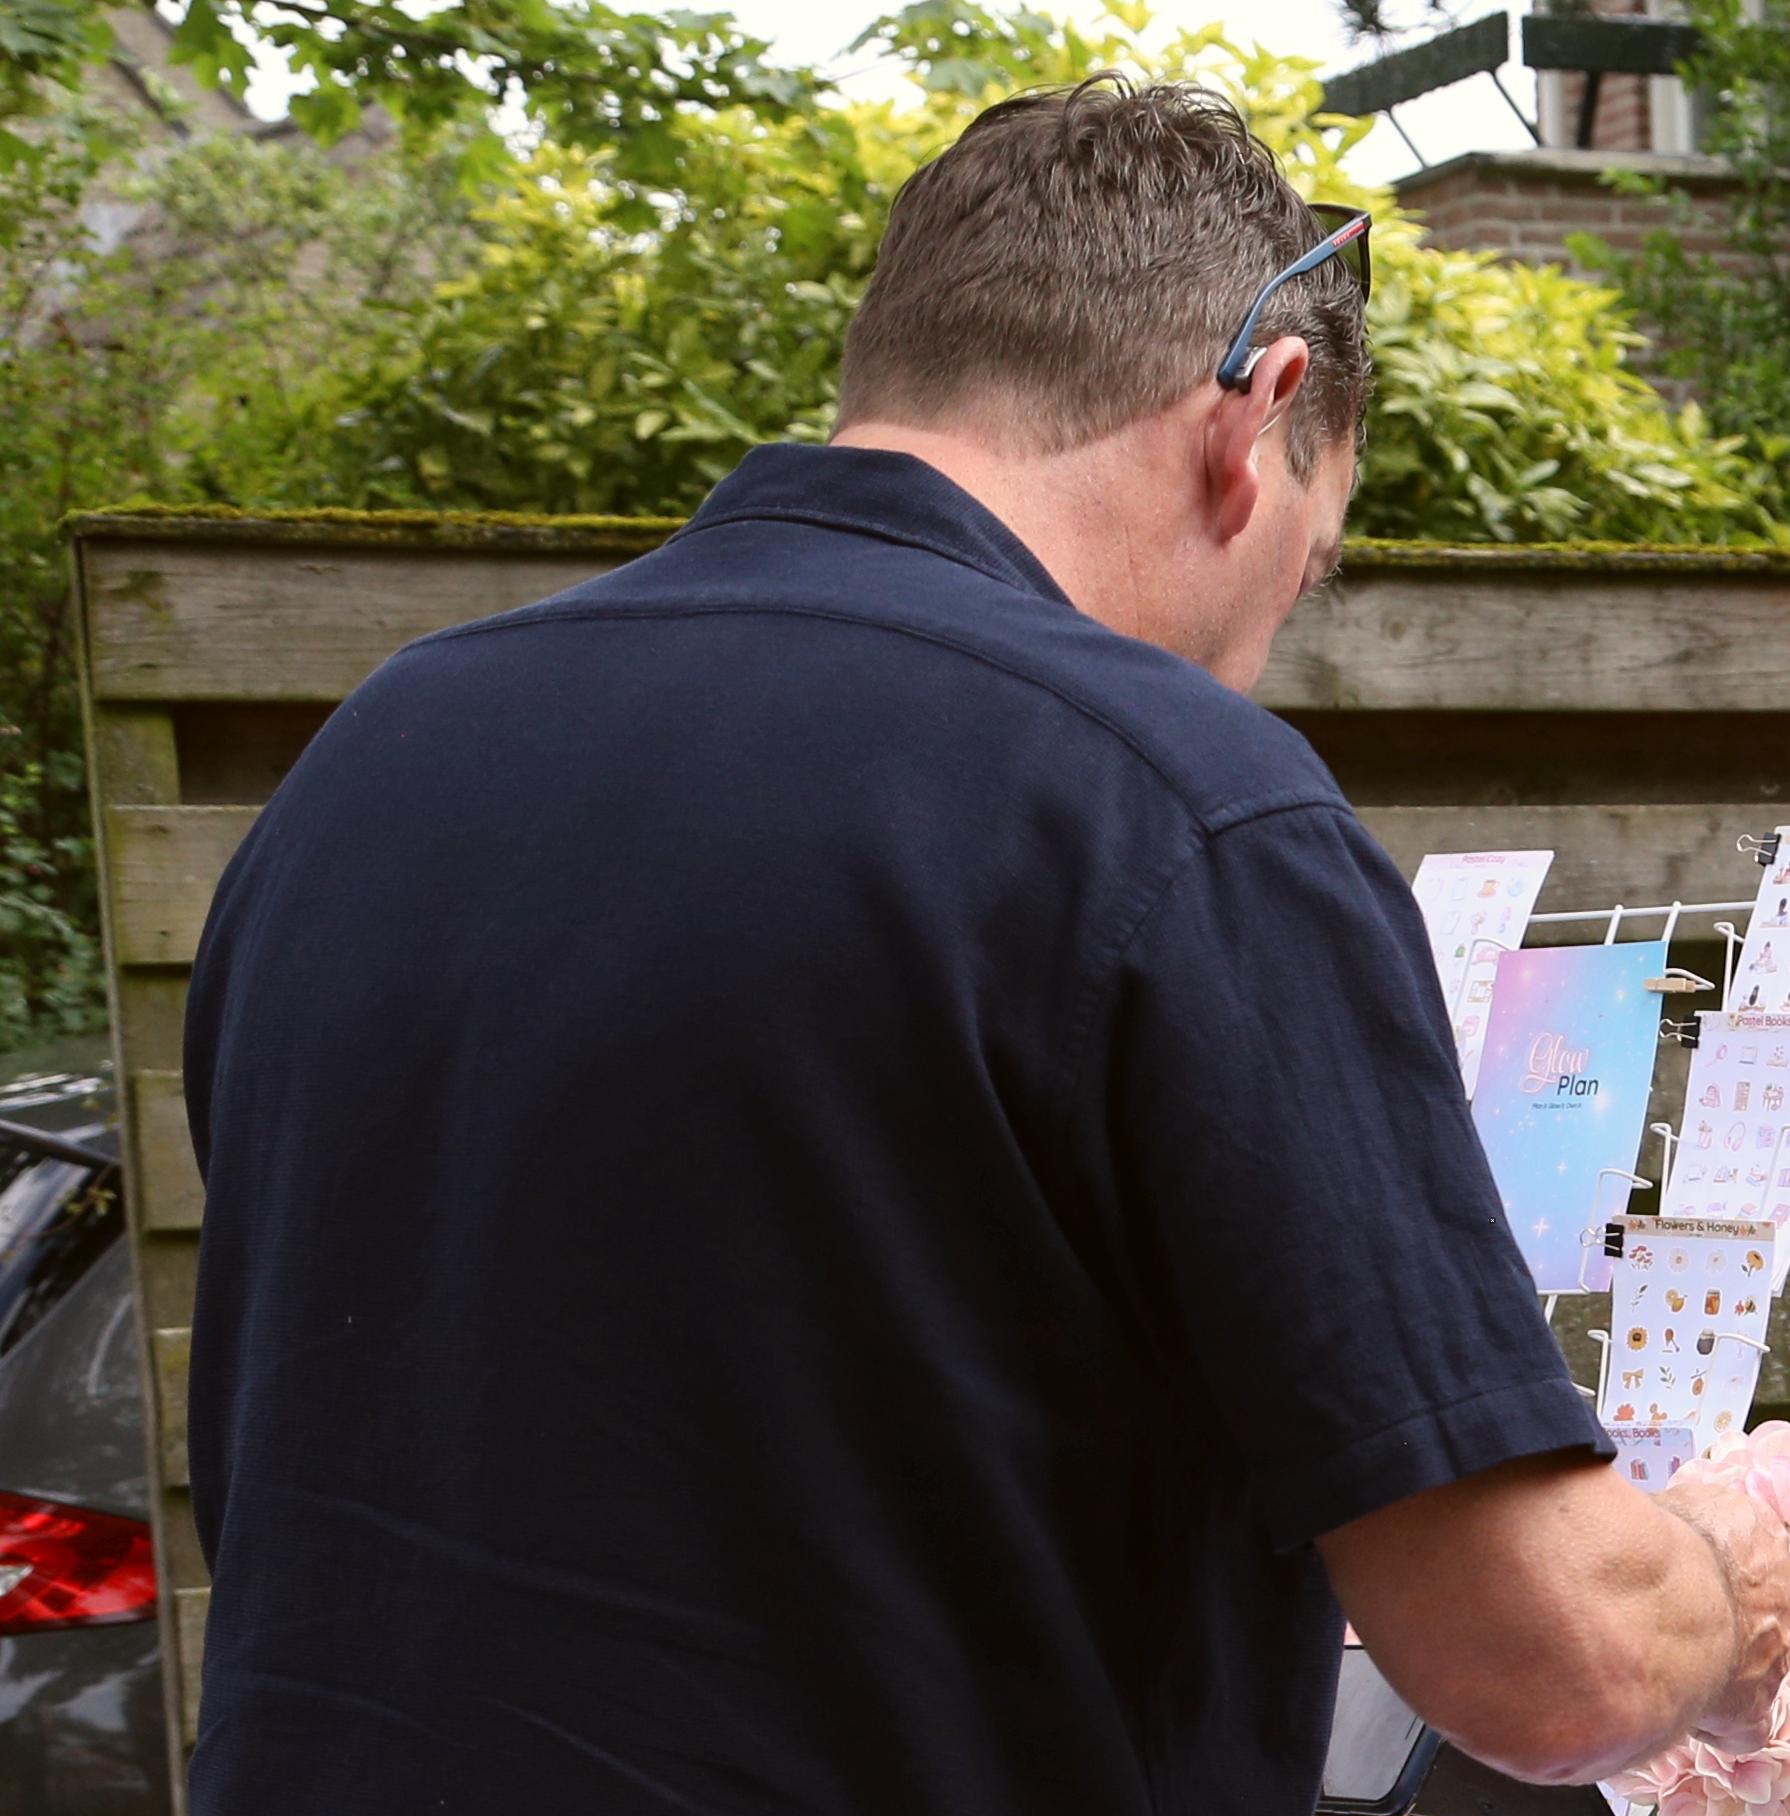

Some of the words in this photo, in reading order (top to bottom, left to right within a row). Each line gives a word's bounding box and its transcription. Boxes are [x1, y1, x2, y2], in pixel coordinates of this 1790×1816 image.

[1738, 1015, 1763, 1026] Pastel
[1520, 1032, 1589, 1094] Glow
[1557, 1074, 1599, 1096] Plan
[1655, 1220, 1695, 1232] Flowers
[1696, 1221, 1705, 1232] &
[1707, 1223, 1740, 1236] Honey
